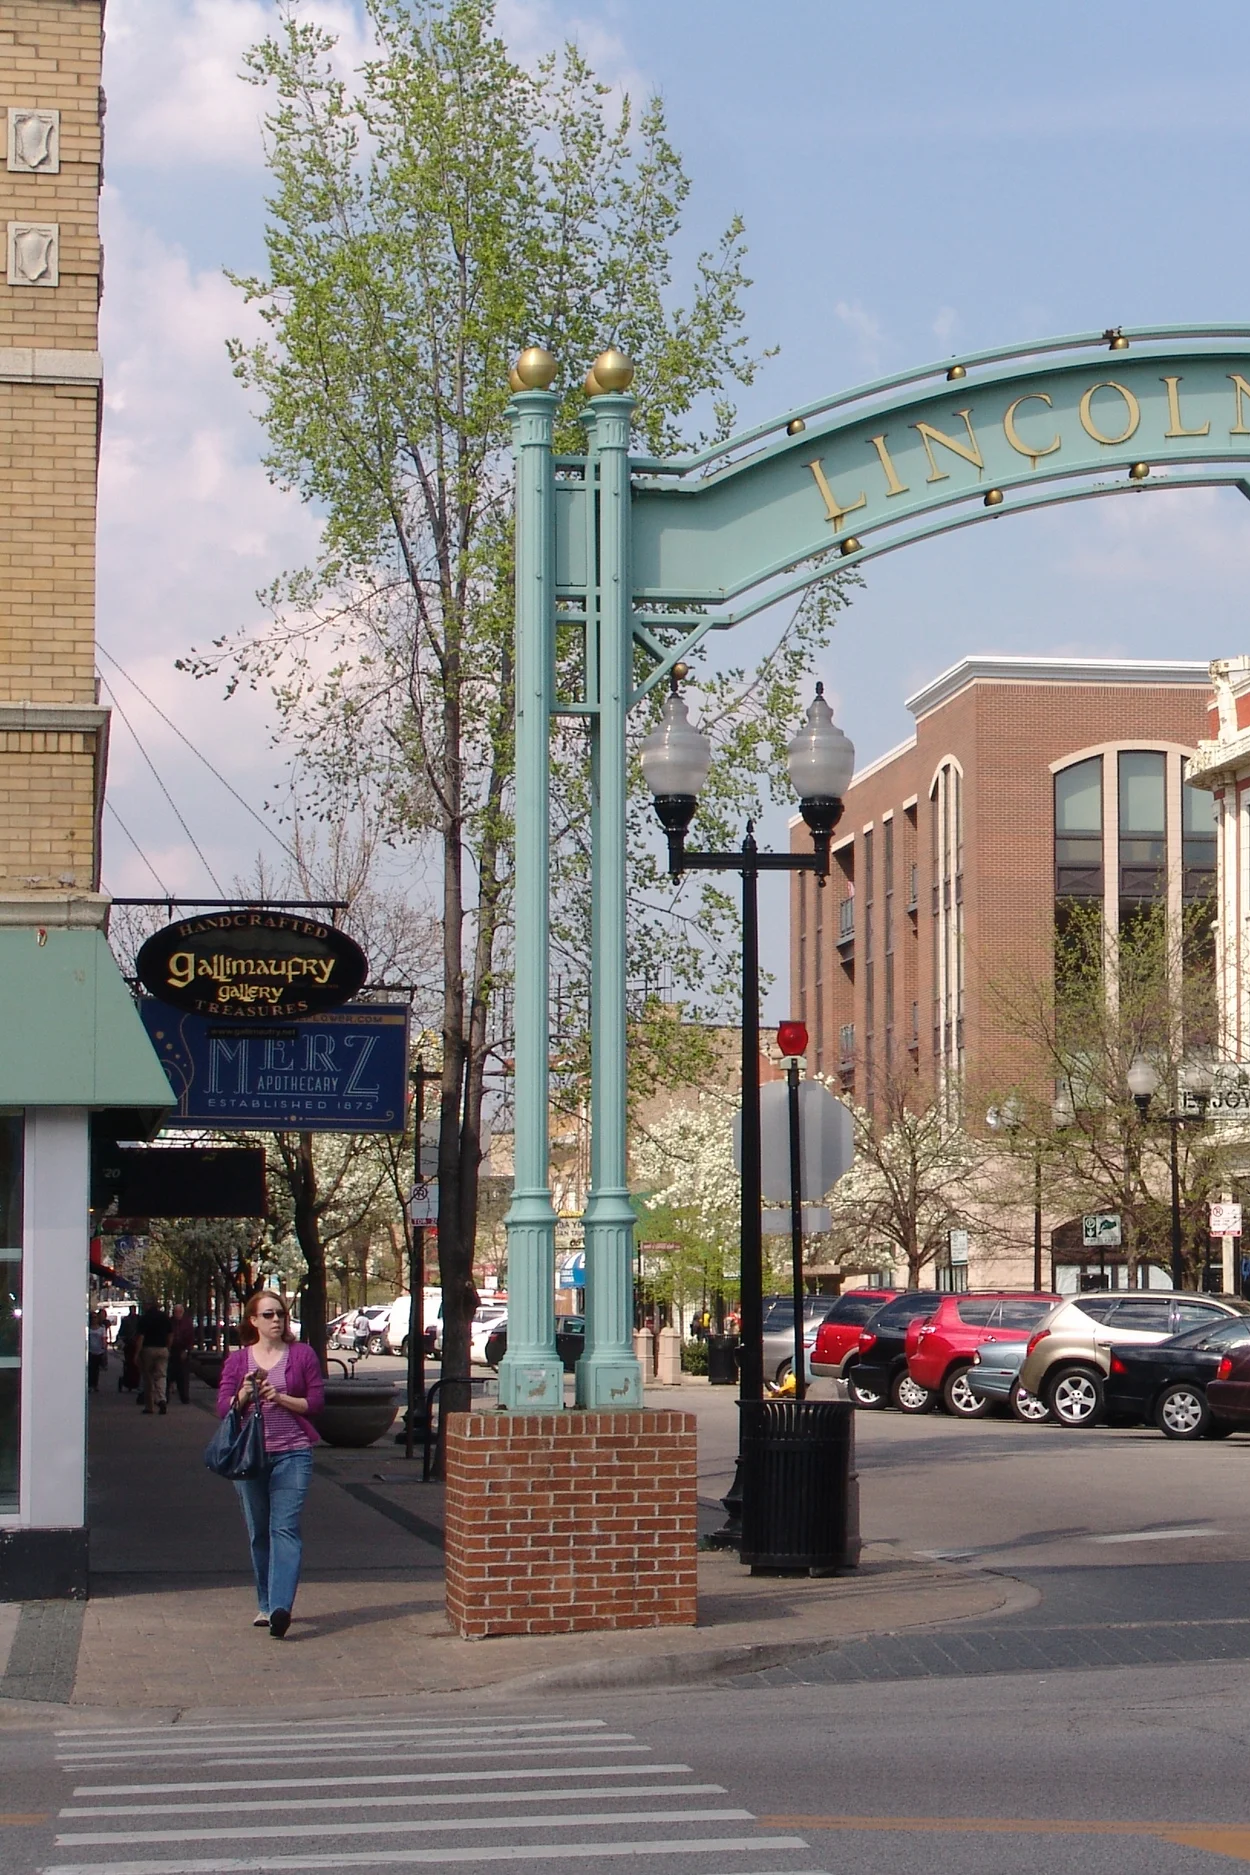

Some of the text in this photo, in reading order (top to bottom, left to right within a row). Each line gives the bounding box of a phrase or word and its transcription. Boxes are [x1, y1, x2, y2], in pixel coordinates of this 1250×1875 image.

[178, 914, 329, 938] HANDCRAFTED
[195, 999, 309, 1017] TREASURES
[203, 1033, 381, 1102] MERZ
[257, 1075, 338, 1092] APOTHECARY
[208, 1098, 374, 1110] ESTABLISHED 1875
